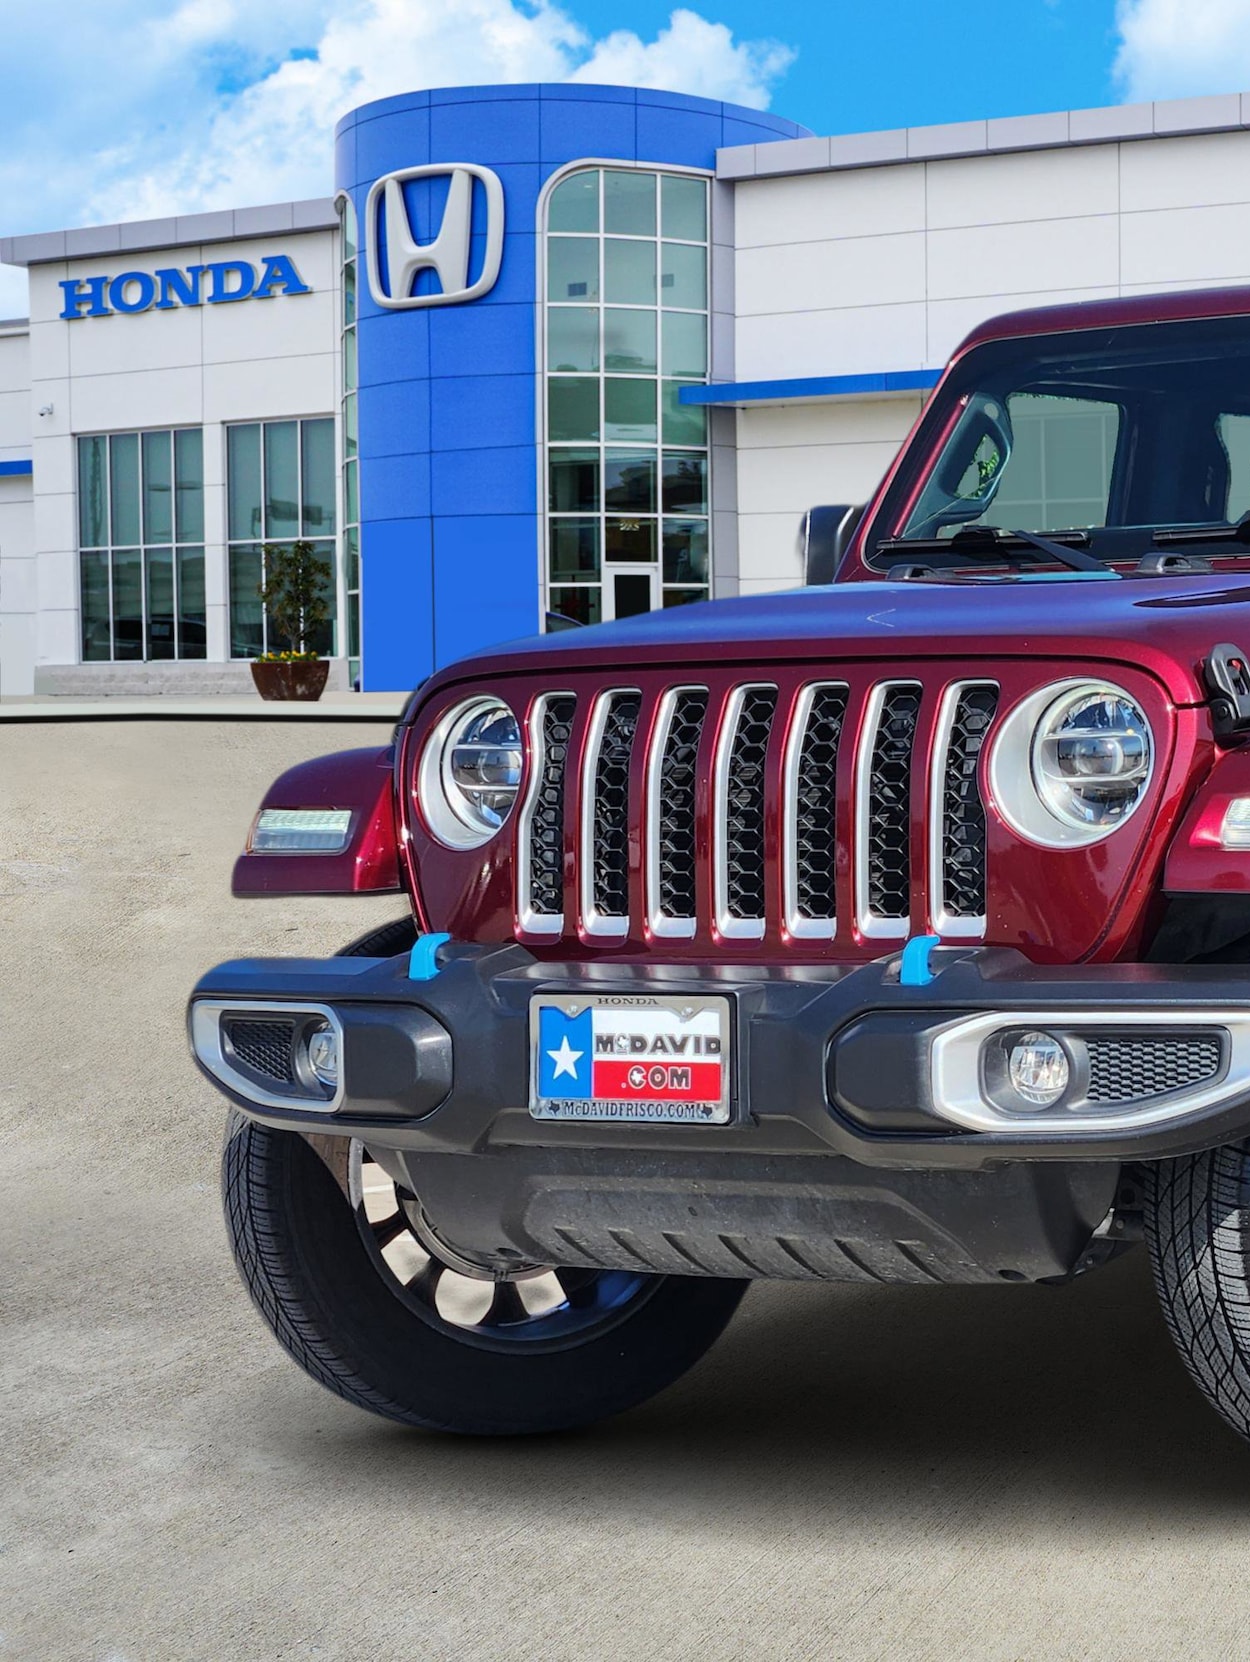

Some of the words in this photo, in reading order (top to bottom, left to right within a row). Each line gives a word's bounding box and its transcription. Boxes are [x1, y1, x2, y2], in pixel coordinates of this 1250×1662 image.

[58, 255, 311, 320] HONDA
[597, 997, 660, 1006] HONDA
[621, 1065, 692, 1089] .COM
